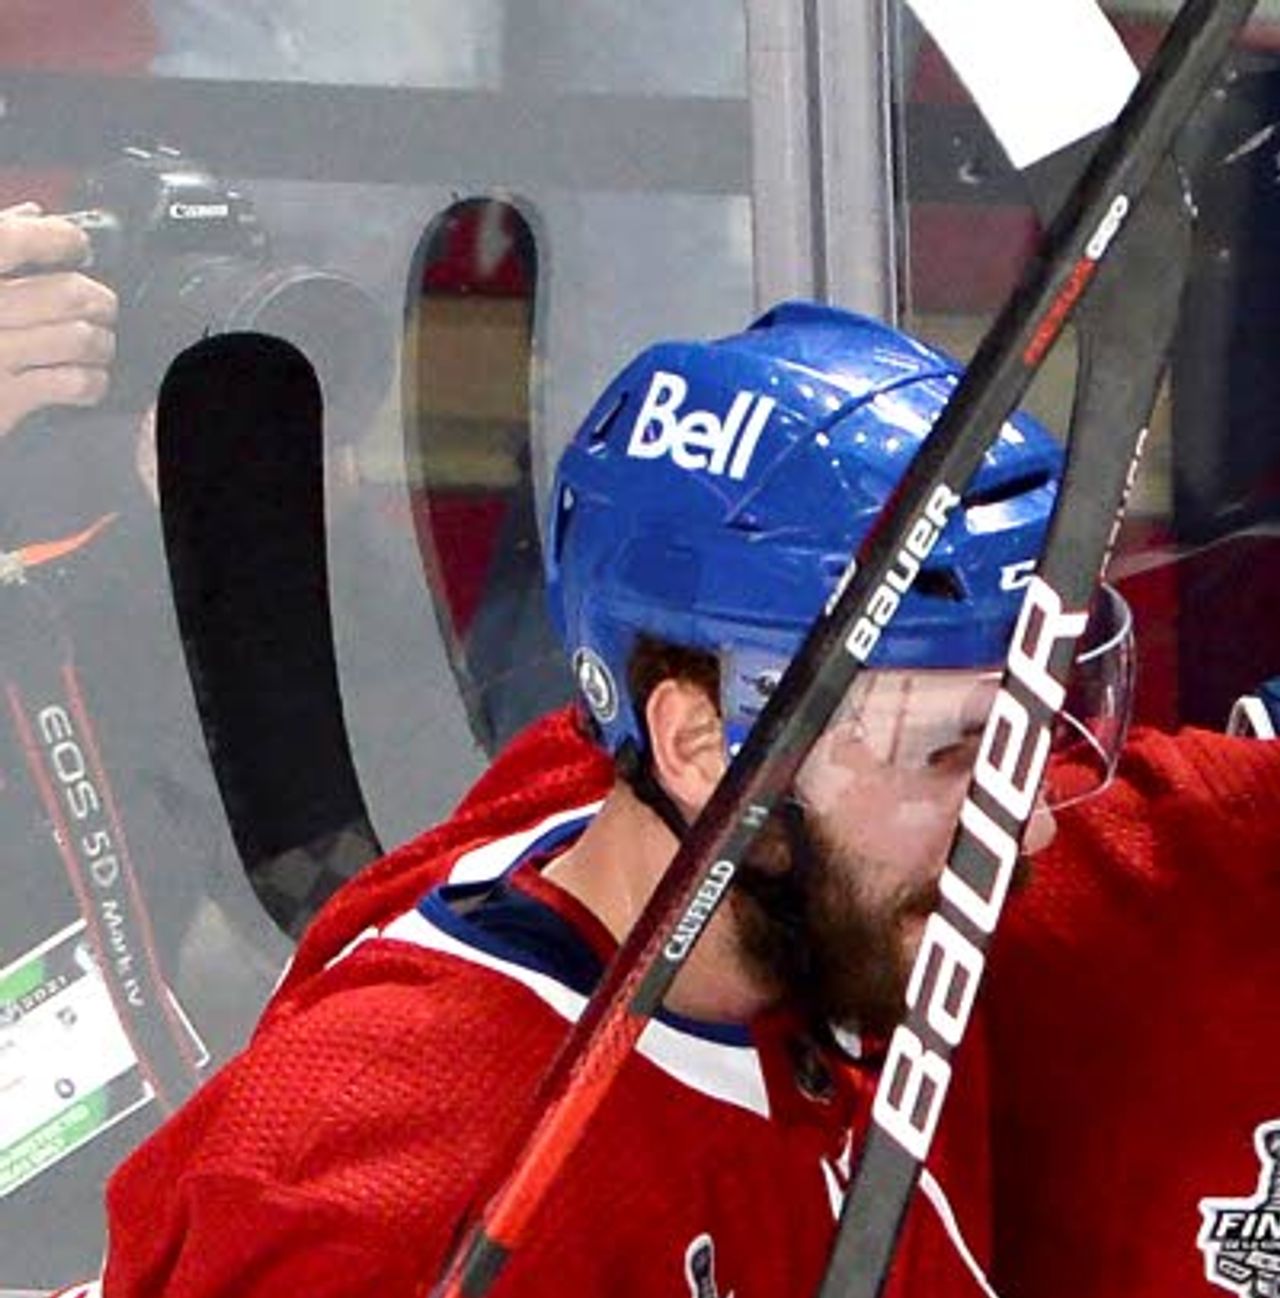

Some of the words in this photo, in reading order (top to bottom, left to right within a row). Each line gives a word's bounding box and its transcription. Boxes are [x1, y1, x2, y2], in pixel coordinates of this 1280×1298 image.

[169, 203, 228, 219] Canon
[627, 370, 776, 480] Bell
[845, 484, 961, 662] BAUER
[38, 704, 100, 820] EOS
[82, 830, 119, 888] 5D
[873, 572, 1088, 1161] BAUER
[664, 859, 735, 960] CAUFIELD
